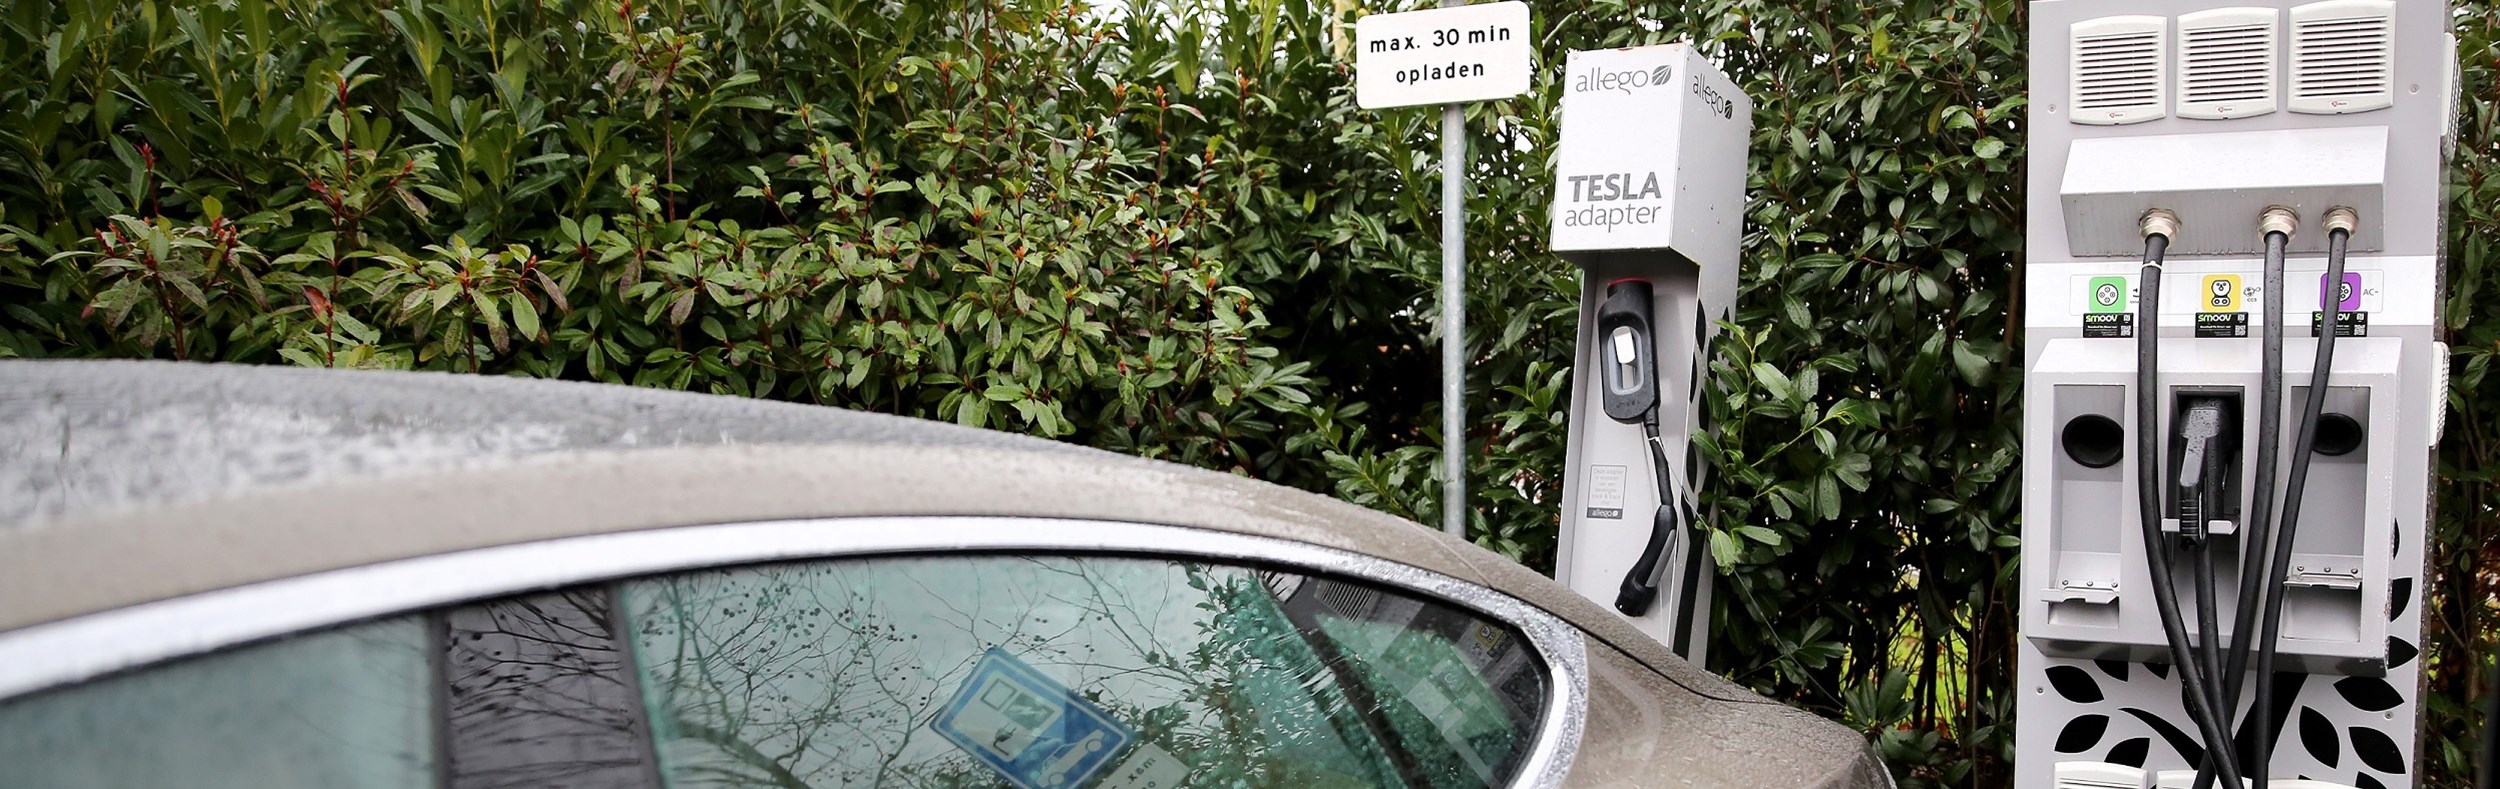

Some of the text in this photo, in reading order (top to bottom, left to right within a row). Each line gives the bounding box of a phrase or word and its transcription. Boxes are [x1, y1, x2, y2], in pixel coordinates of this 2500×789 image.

[1369, 25, 1511, 54] max. 30 min
[1395, 61, 1485, 85] opladen
[1575, 66, 1649, 95] allego
[1692, 73, 1724, 117] allego
[1568, 171, 1662, 202] TESLA
[1564, 204, 1662, 233] adapter
